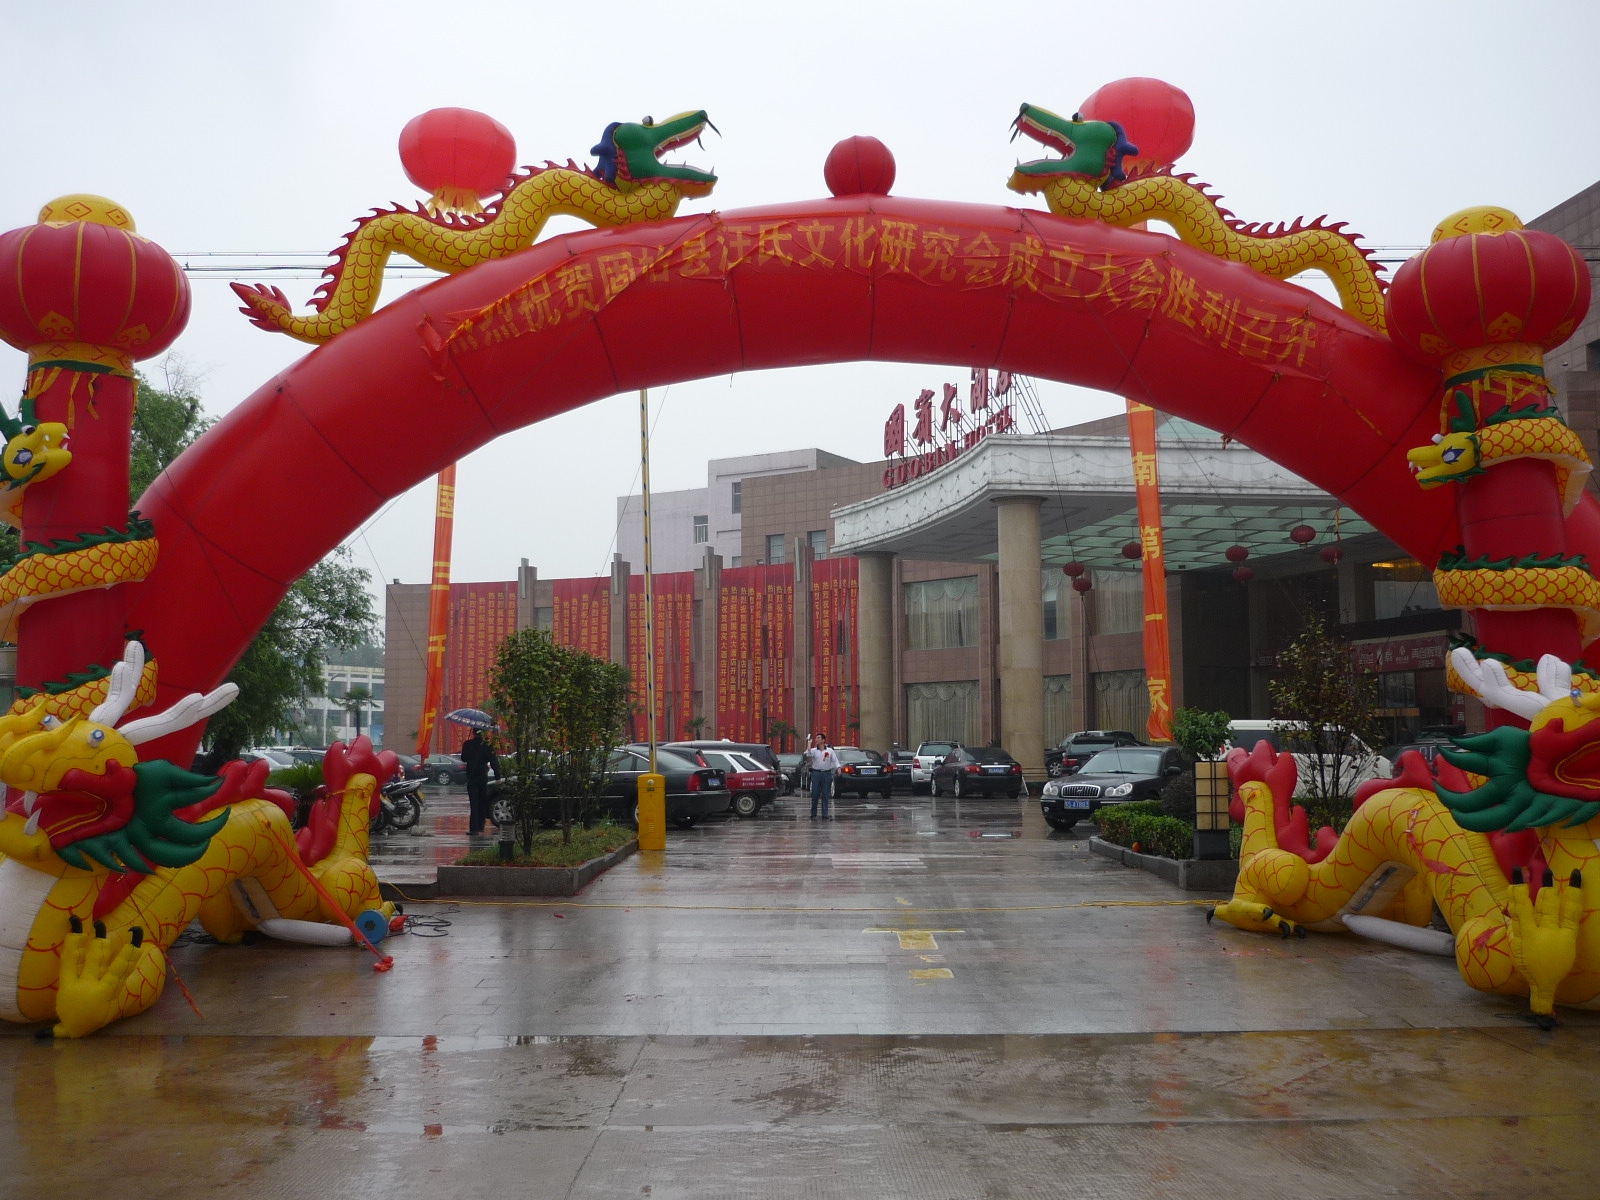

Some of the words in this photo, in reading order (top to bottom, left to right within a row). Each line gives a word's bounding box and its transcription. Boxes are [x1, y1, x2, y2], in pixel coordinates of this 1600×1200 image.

[449, 217, 1318, 369] 烈祝贺固始县汪氏文化研究会成立大会胜利召开
[882, 439, 958, 488] GUOBIN
[962, 404, 1014, 452] HOTEL
